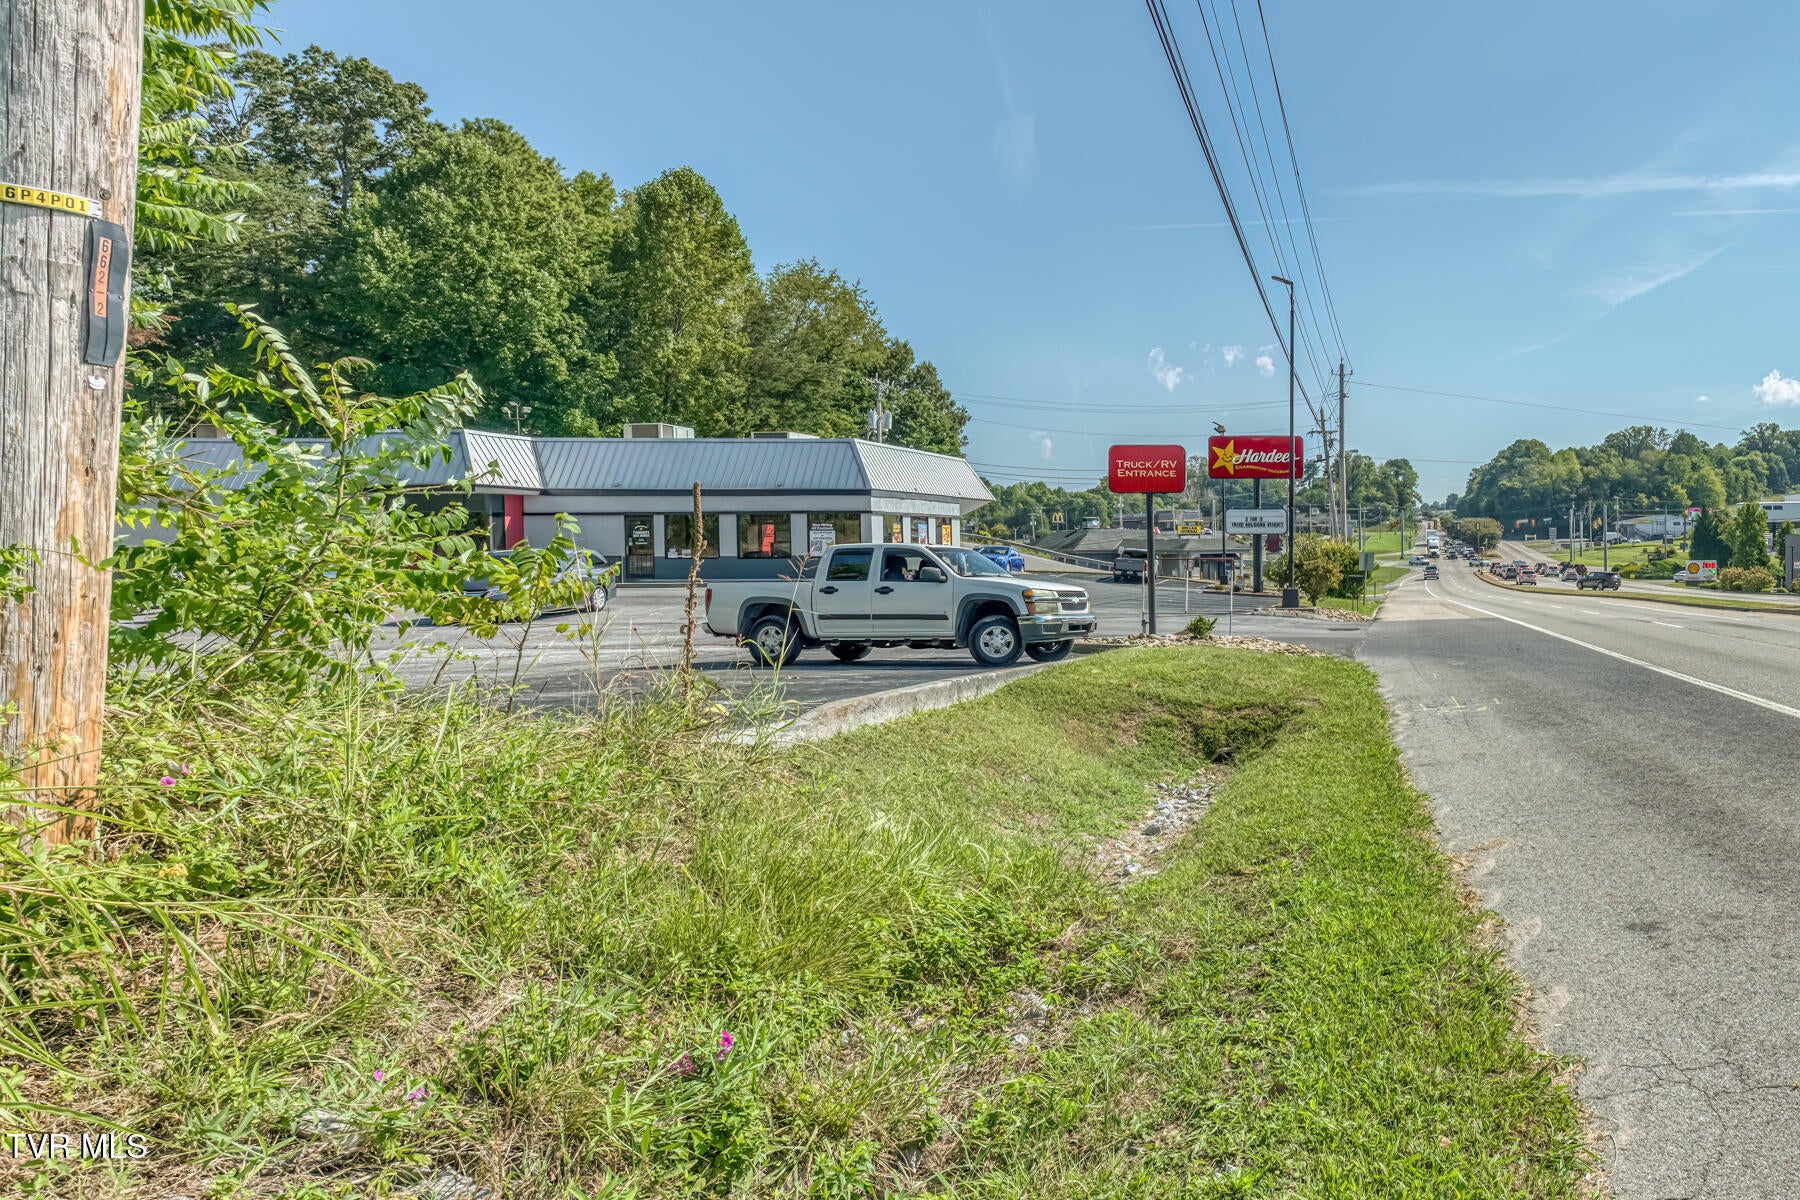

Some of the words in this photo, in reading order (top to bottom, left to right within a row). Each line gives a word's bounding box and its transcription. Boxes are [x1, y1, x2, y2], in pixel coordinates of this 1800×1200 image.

[1232, 449, 1300, 465] Hardee
[1116, 459, 1177, 469] TRUCK/RV
[1117, 469, 1177, 478] ENTRANCE
